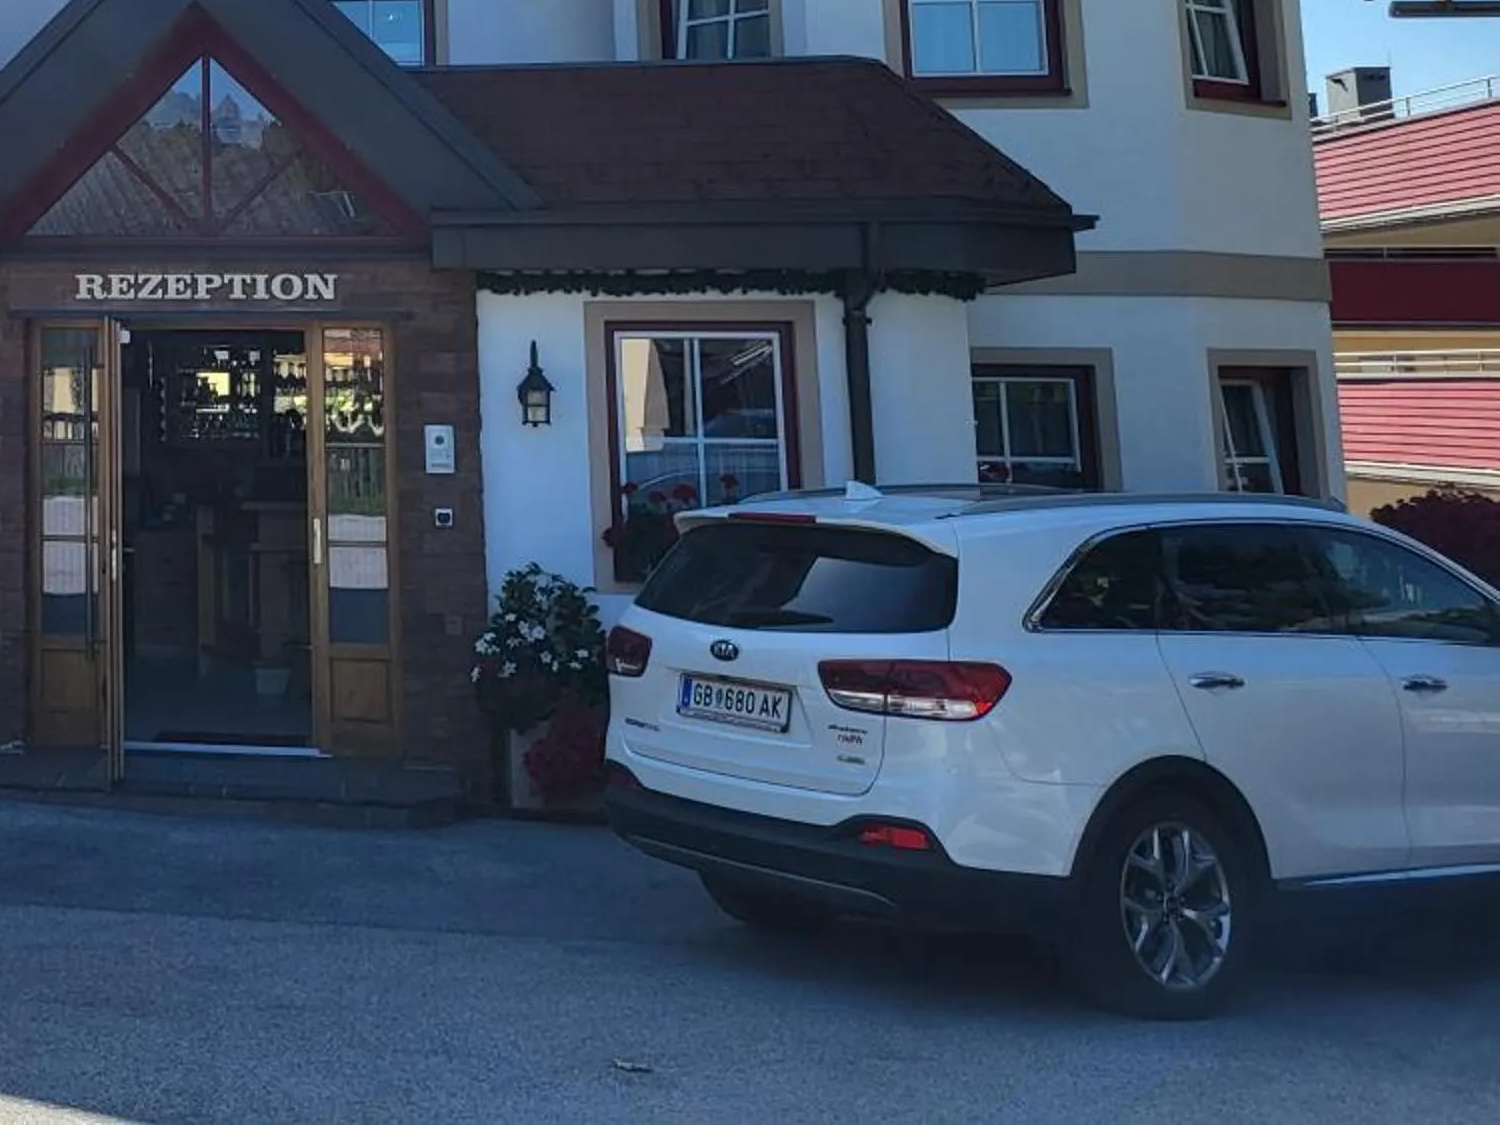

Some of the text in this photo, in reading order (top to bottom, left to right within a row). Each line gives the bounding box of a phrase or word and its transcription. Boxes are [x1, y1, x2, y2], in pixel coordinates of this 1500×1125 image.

[75, 274, 338, 300] REZEPTION
[693, 683, 783, 719] GB 680 AK
